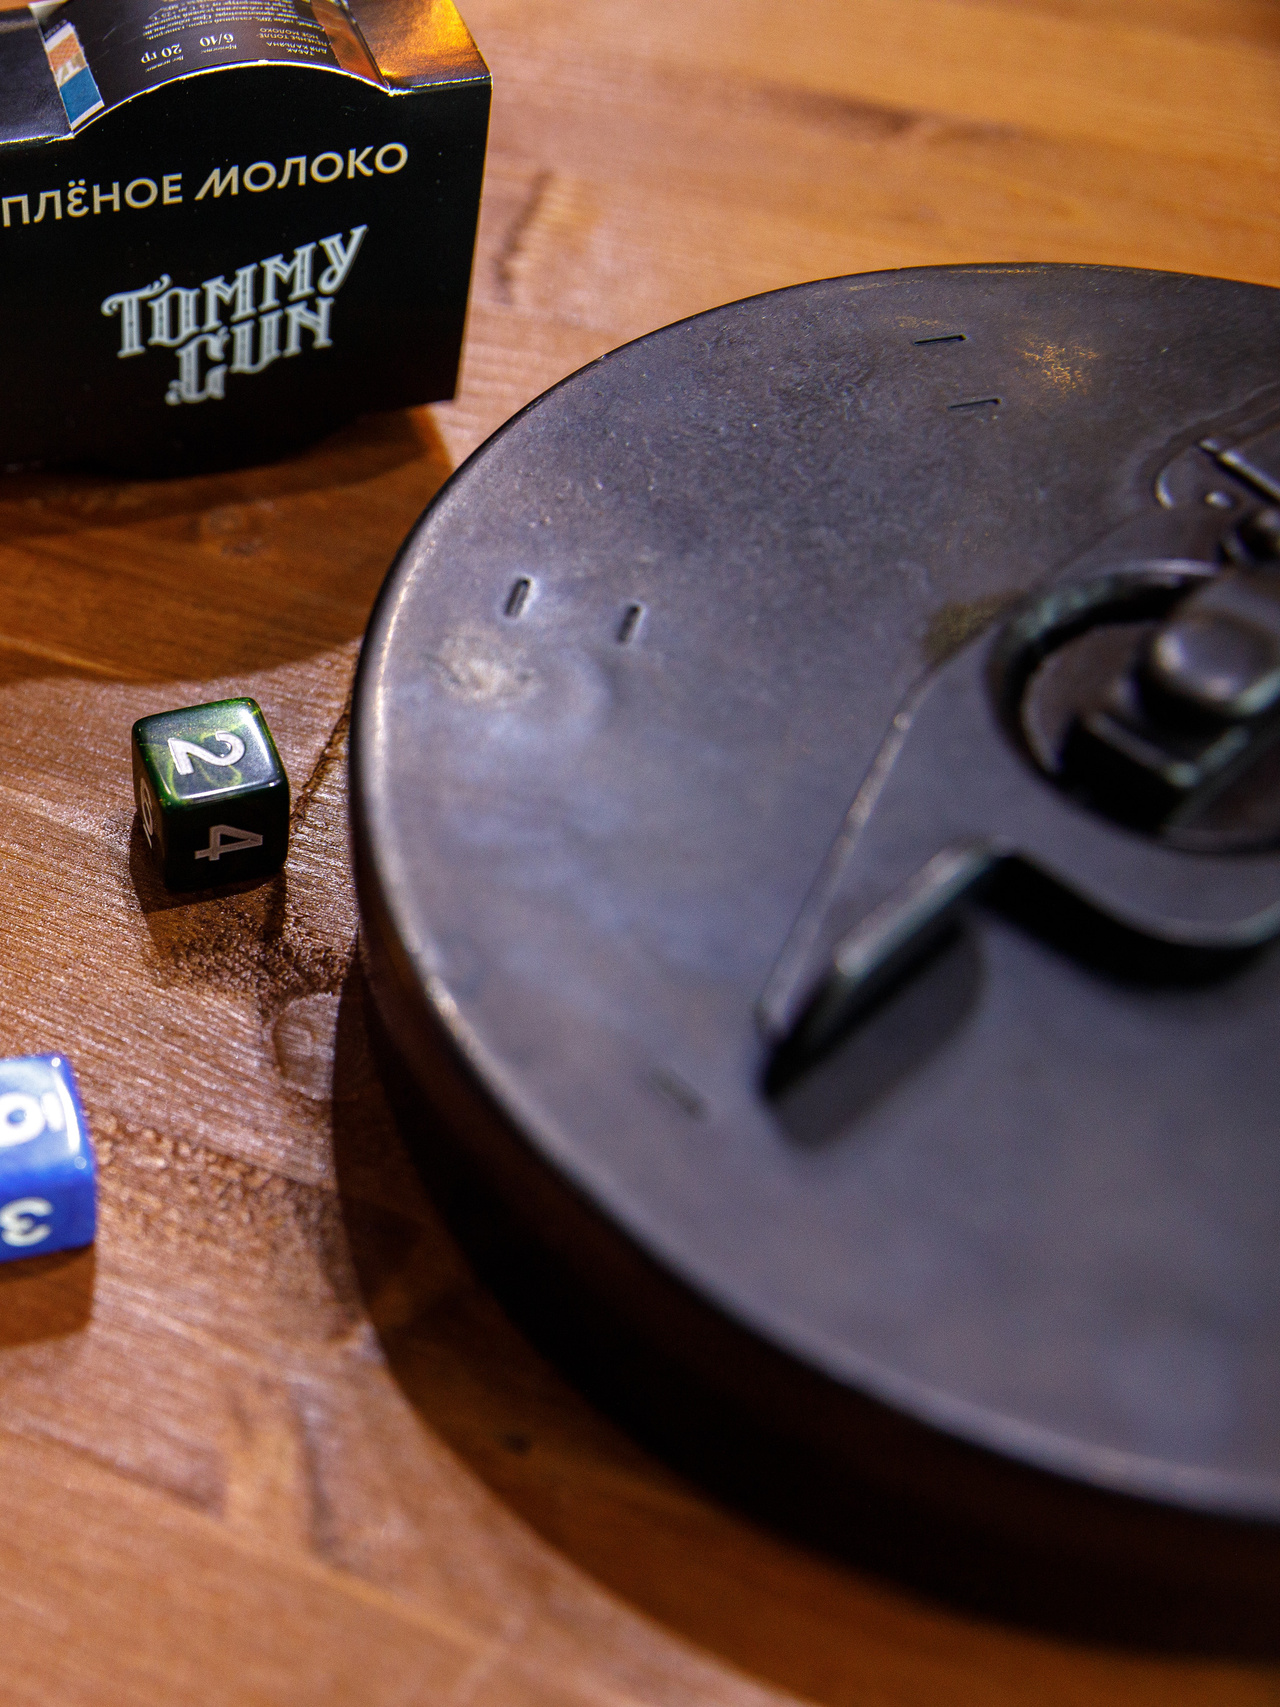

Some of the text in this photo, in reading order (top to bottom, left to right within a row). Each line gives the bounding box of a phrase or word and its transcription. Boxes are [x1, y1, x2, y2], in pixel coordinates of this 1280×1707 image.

[140, 43, 182, 64] 20 гр
[199, 33, 234, 47] 6/10
[194, 142, 409, 201] МОЛОКО
[101, 224, 368, 359] TOMMY
[165, 297, 335, 405] GUN
[167, 730, 246, 776] 2
[194, 824, 264, 862] 4
